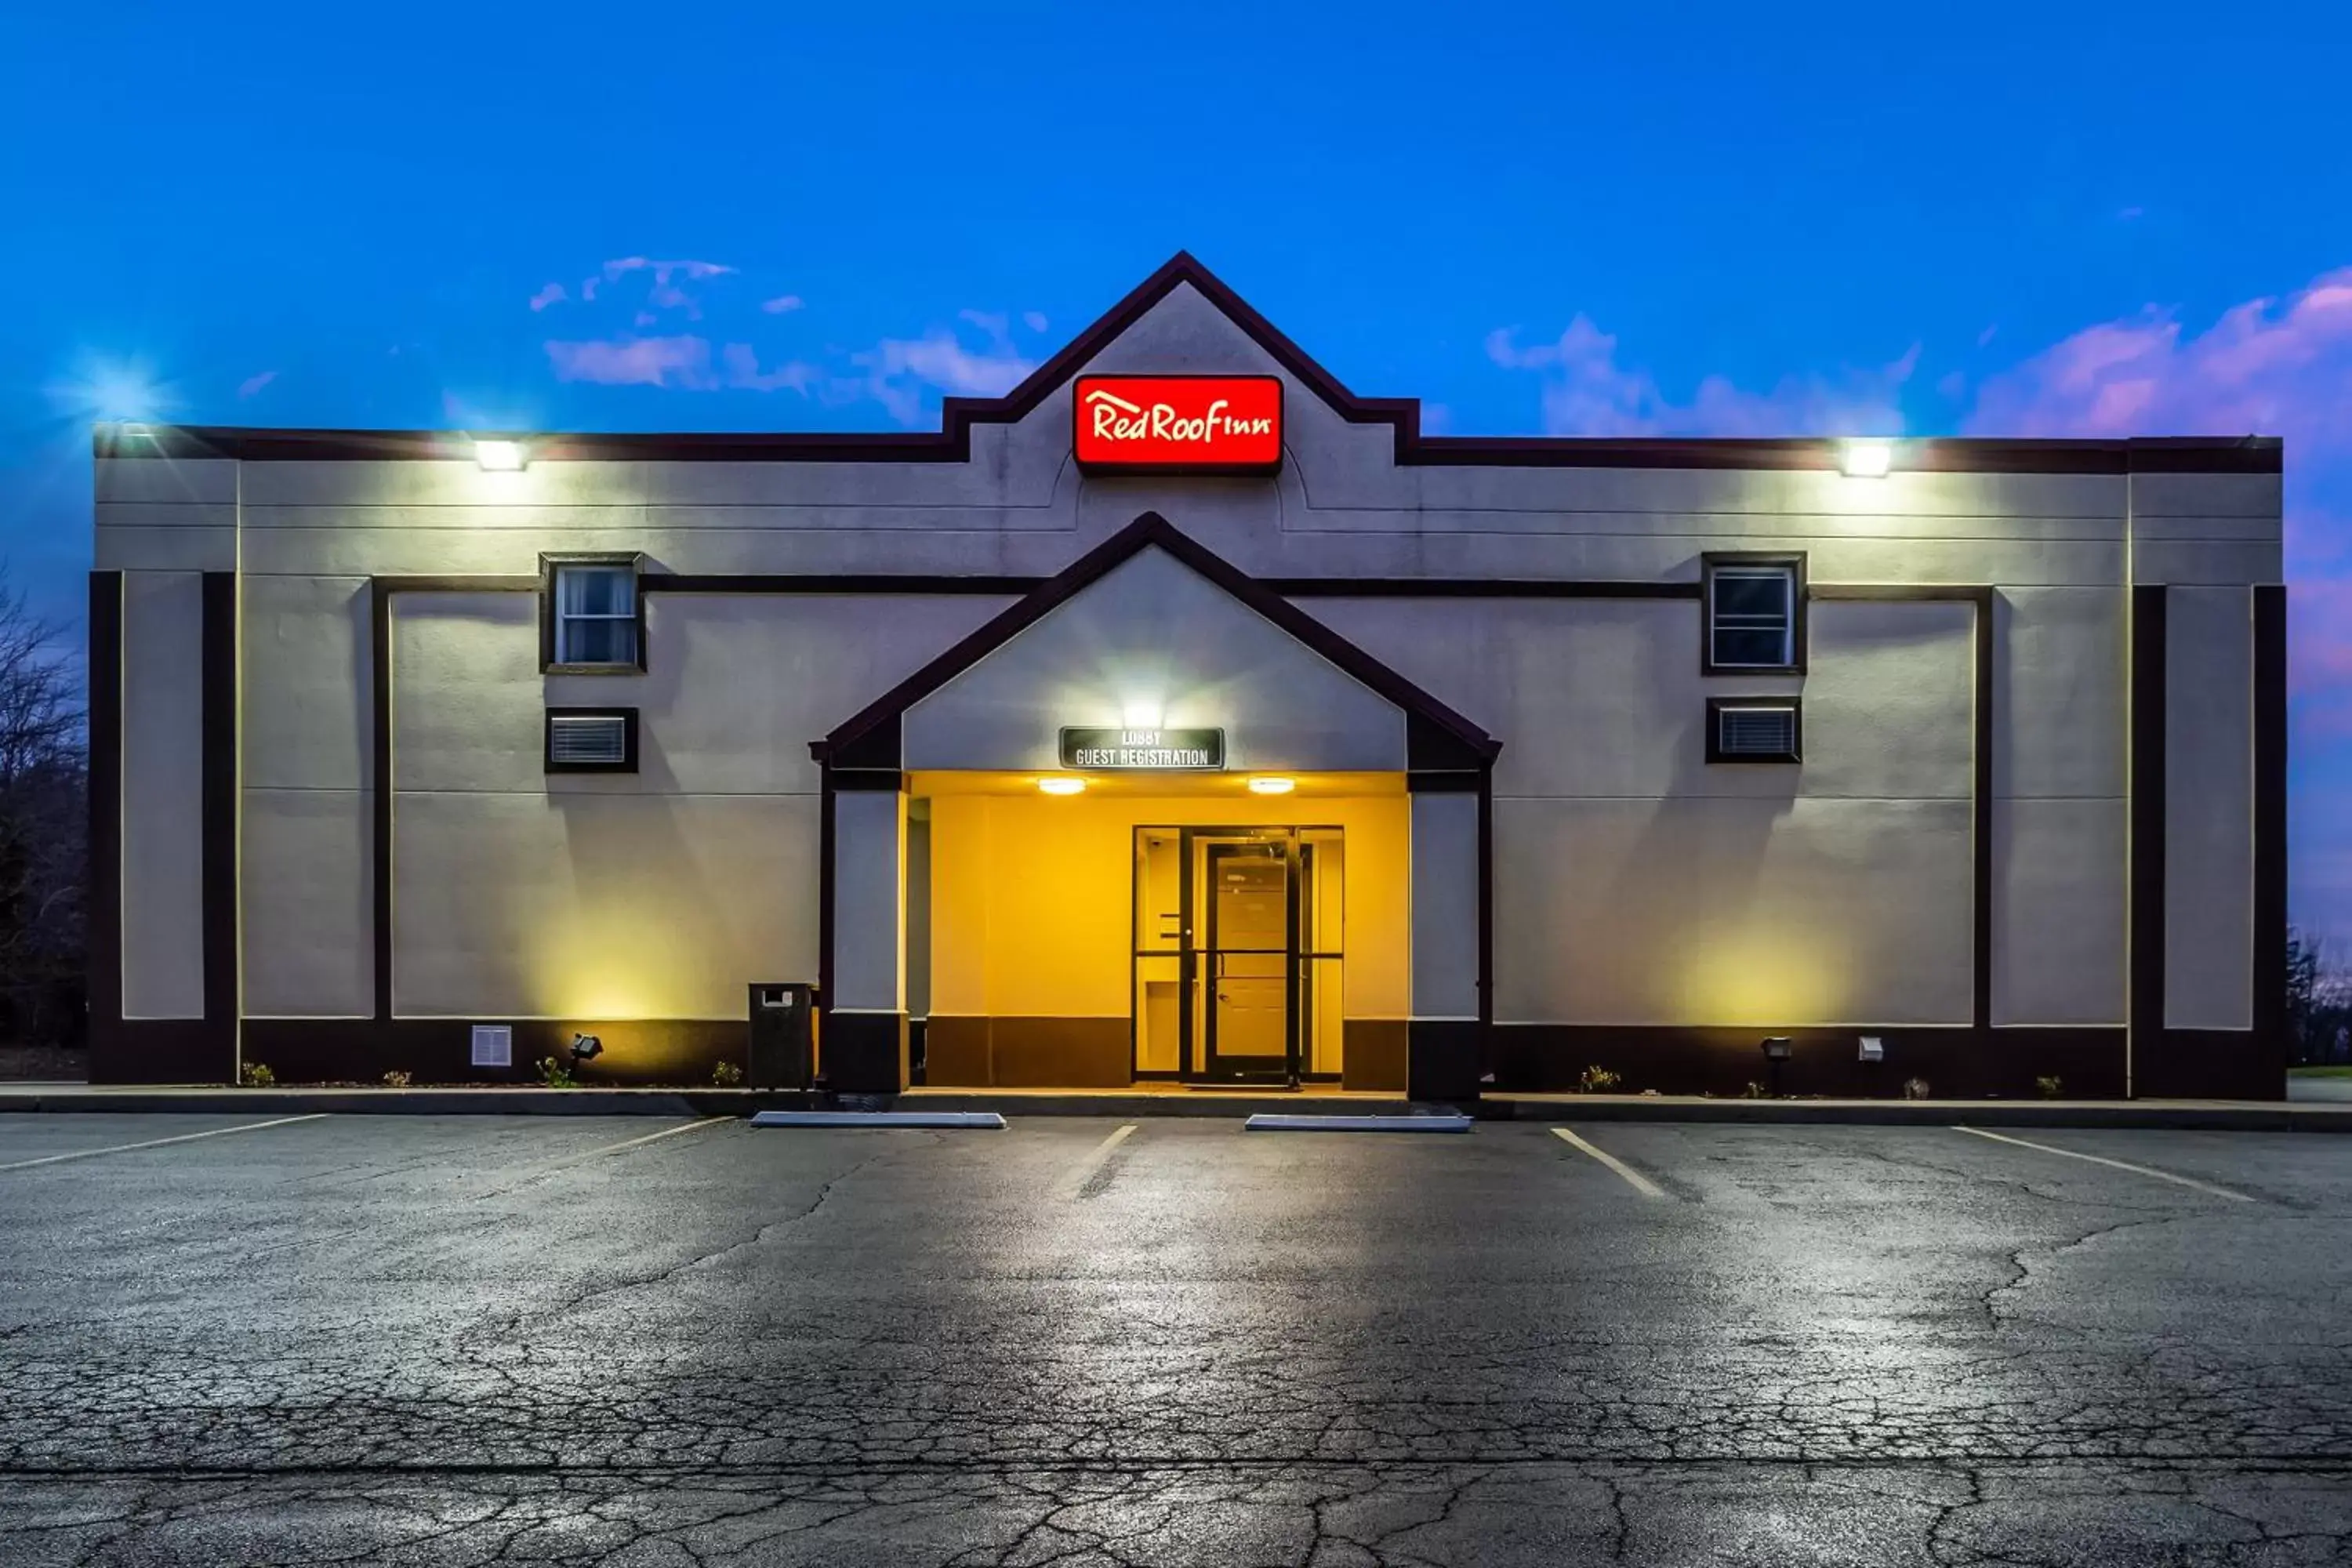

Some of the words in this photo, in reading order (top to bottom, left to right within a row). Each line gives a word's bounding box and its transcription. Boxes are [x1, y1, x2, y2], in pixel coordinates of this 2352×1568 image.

[1094, 403, 1149, 441] Red
[1152, 399, 1229, 443] Roof
[1224, 416, 1272, 435] Inn
[1122, 731, 1161, 746] LOBBY
[1076, 749, 1116, 765] GUEST
[1120, 749, 1208, 765] REGISTRATION
